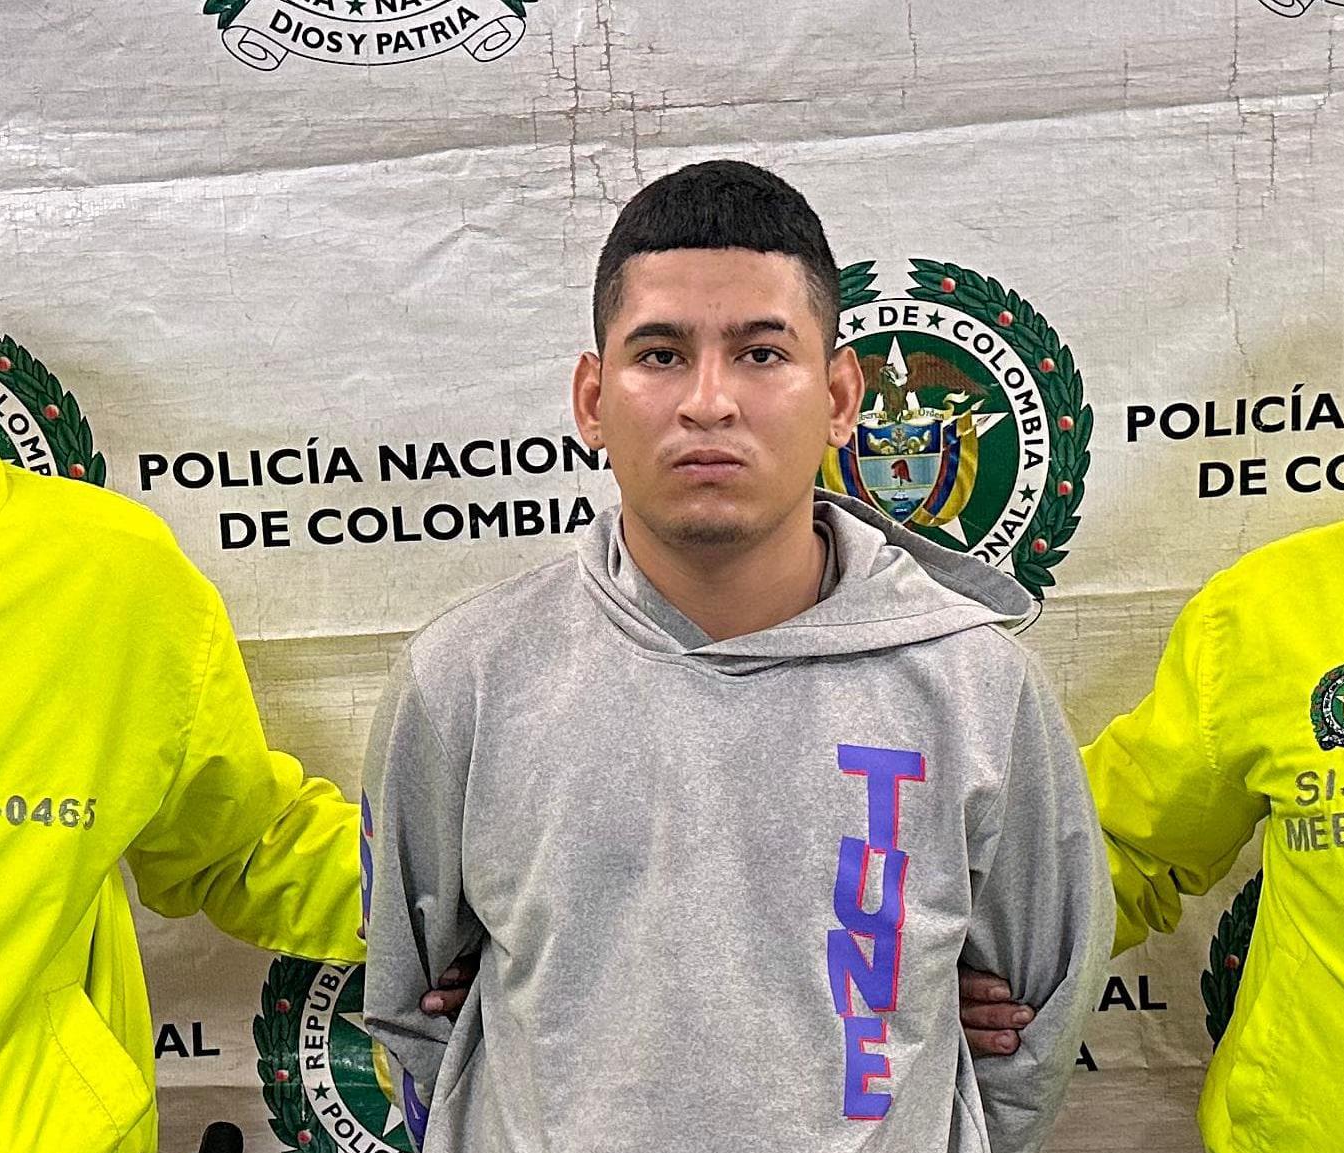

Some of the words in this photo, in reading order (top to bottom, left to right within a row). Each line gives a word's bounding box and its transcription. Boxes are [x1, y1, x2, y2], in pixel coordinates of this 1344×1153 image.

[269, 9, 343, 53] DIOS
[347, 33, 368, 55] Y
[377, 5, 480, 54] PATRIA
[879, 305, 919, 327] DE
[952, 319, 1044, 471] COLOMBIA
[138, 437, 363, 491] POLICÍA
[379, 436, 612, 482] NACION
[1198, 458, 1267, 498] DE
[219, 510, 291, 550] DE
[307, 496, 596, 545] COLOMBIA
[973, 505, 1032, 565] ONAL
[827, 743, 926, 1121] TUNE
[306, 964, 352, 1071] REPÚBL
